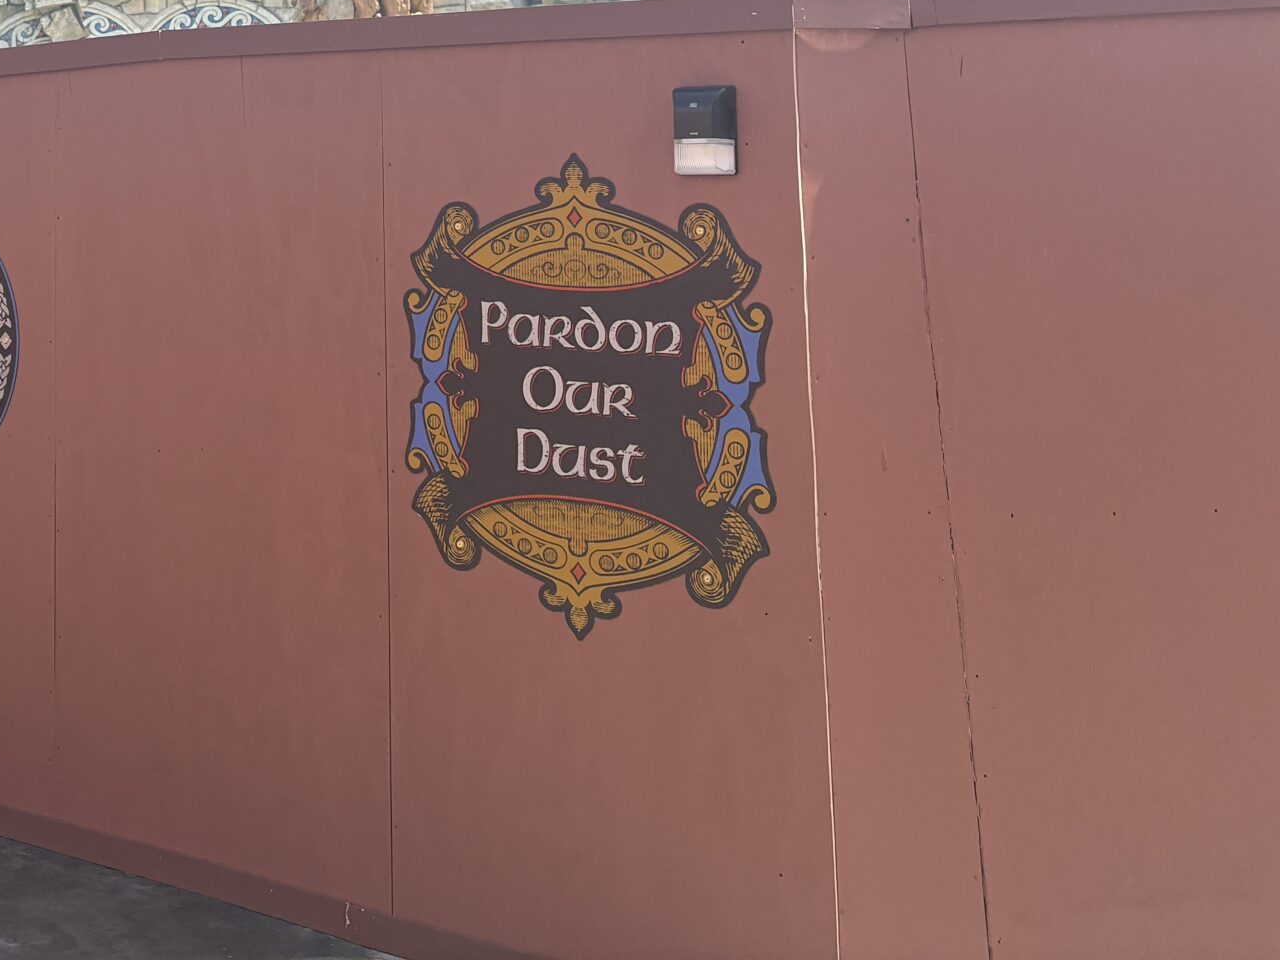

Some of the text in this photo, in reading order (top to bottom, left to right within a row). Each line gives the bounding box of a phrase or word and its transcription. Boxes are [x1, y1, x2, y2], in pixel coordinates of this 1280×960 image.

[480, 300, 682, 356] Pardon
[522, 365, 637, 418] Our
[516, 427, 645, 485] Dust
